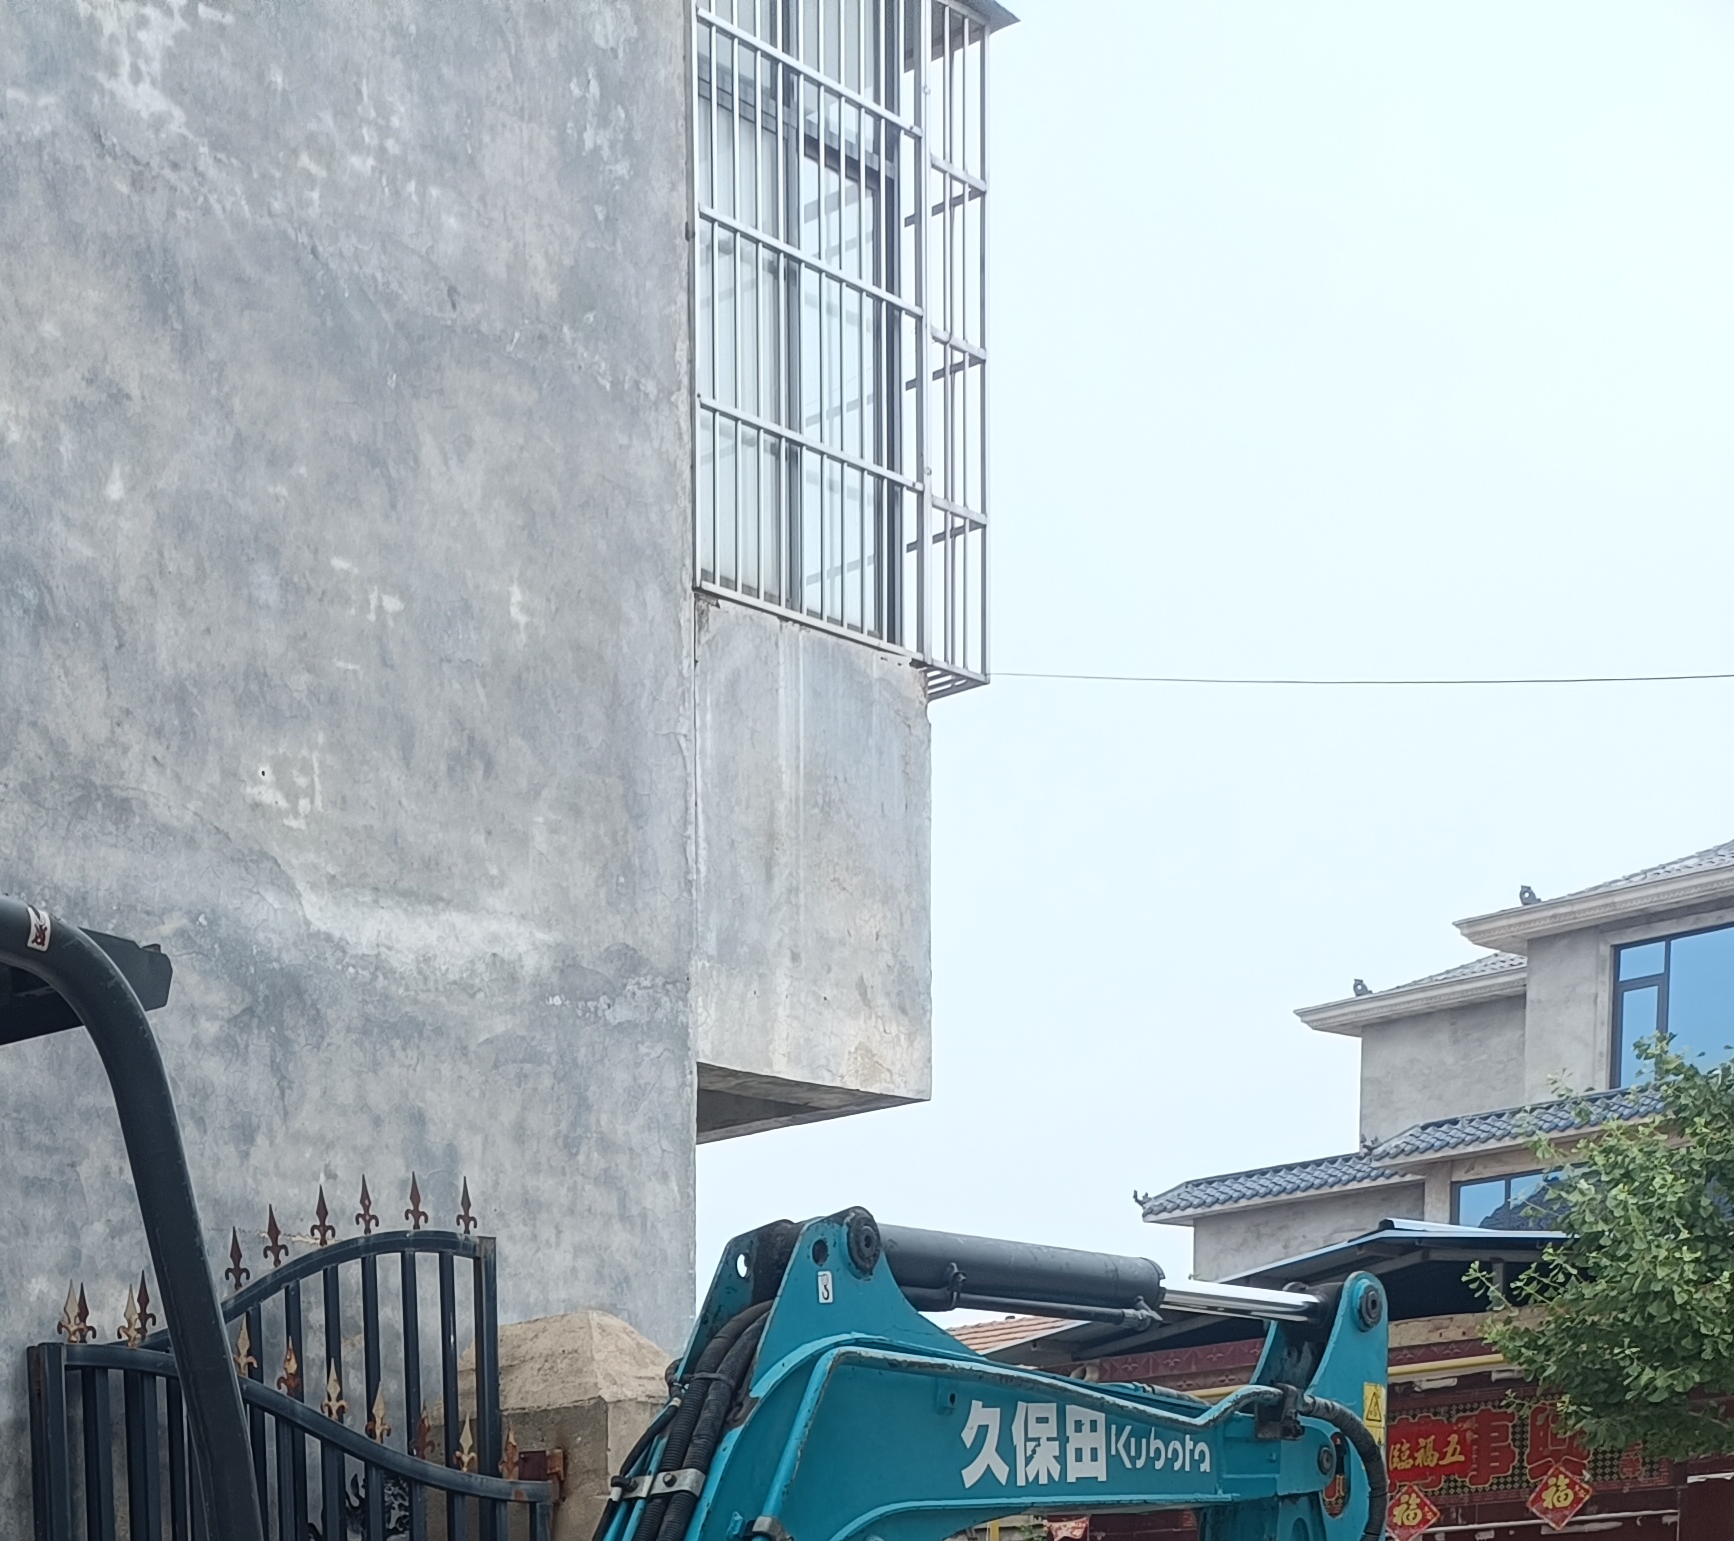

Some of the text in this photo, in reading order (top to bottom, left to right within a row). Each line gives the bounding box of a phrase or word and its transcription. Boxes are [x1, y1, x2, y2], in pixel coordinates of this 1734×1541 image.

[961, 1400, 1107, 1489] 久保田
[1110, 1424, 1211, 1473] Kubota
[1392, 1492, 1423, 1526] 福
[1541, 1474, 1575, 1509] 福
